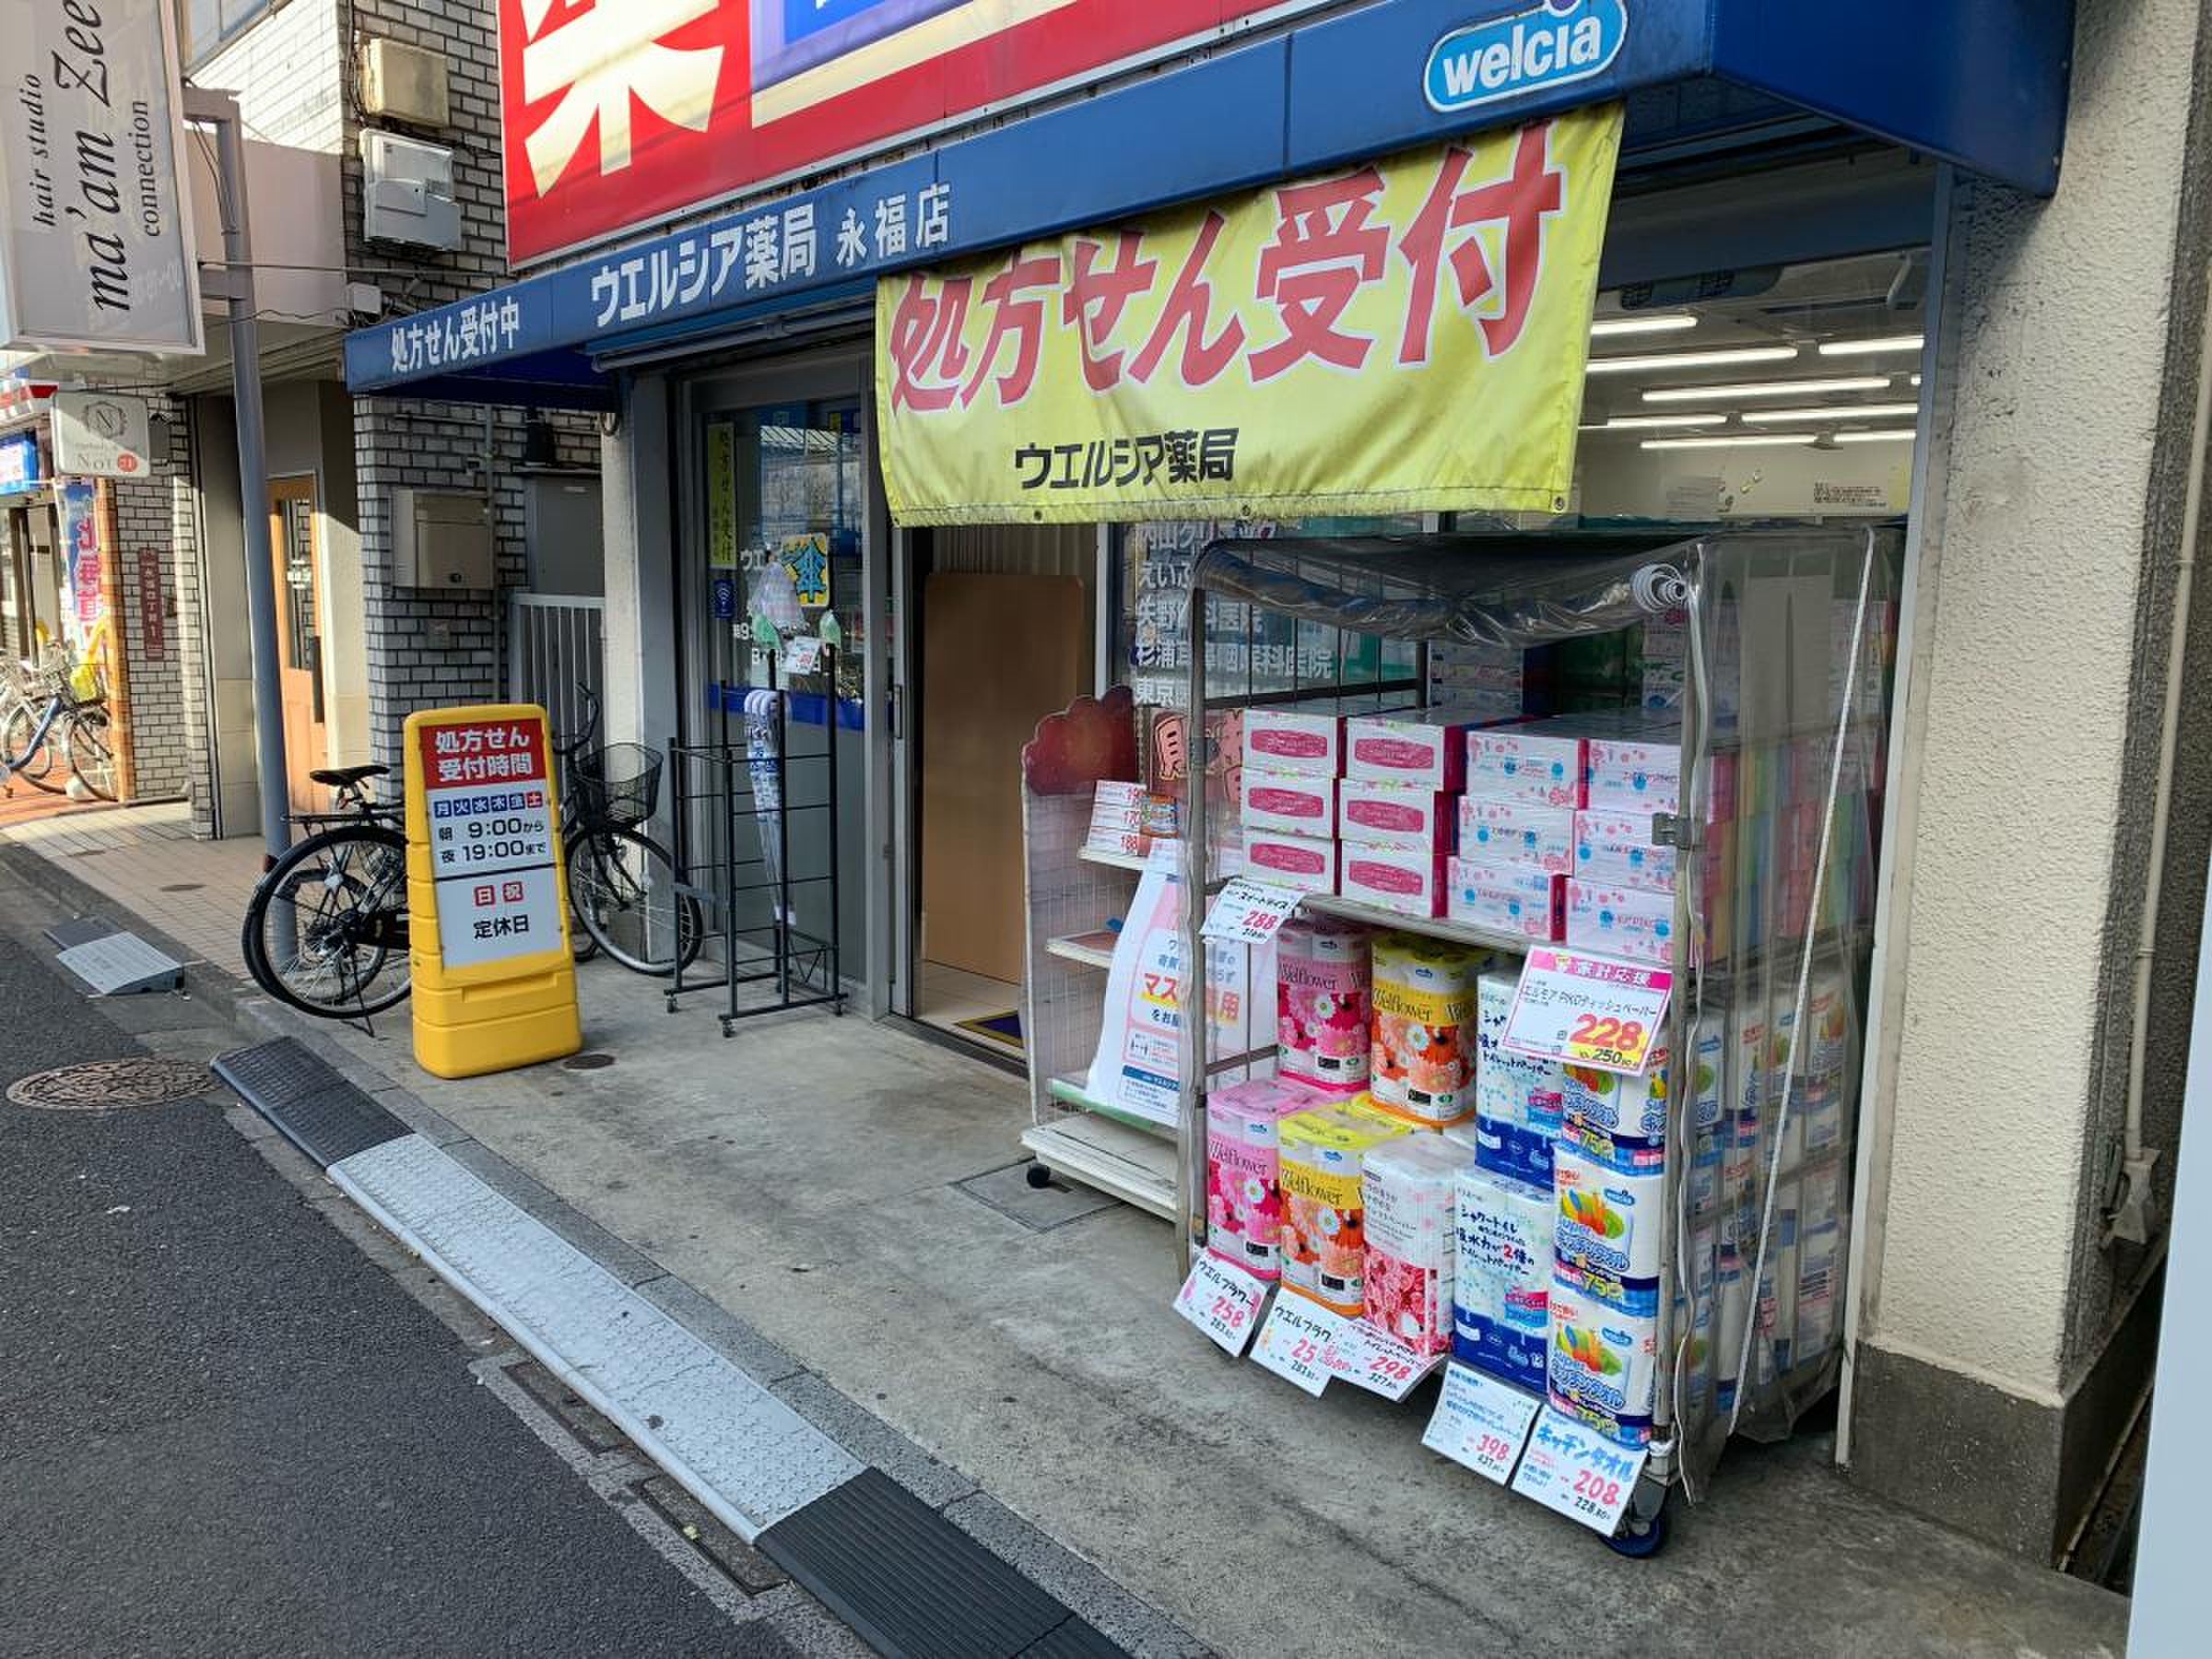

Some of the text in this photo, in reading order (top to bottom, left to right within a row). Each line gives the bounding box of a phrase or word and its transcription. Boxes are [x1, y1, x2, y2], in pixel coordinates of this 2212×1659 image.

[1443, 16, 1602, 98] welcia
[19, 74, 55, 227] hair studio
[127, 100, 160, 237] connection
[65, 131, 131, 311] ma'am
[591, 183, 951, 328] ウエルシア薬局 永福店
[889, 122, 1564, 415] 処方せん受付
[391, 296, 521, 373] 処方せん受付中
[1014, 427, 1240, 490] ウエルシア薬局
[435, 725, 531, 754] 処方せん
[438, 751, 533, 782] 受付時間
[439, 826, 453, 841] 朝
[441, 849, 455, 864] 夜
[473, 914, 531, 939] 定休日
[1242, 909, 1279, 930] 288
[1570, 1013, 1643, 1052] 228
[1198, 1259, 1255, 1308] ウエルフラワー
[1211, 1296, 1243, 1328] 258
[1370, 1356, 1413, 1381] 298
[1476, 1433, 1512, 1462] 398
[1536, 1423, 1635, 1482] キッチンタオル
[1573, 1469, 1622, 1506] 208
